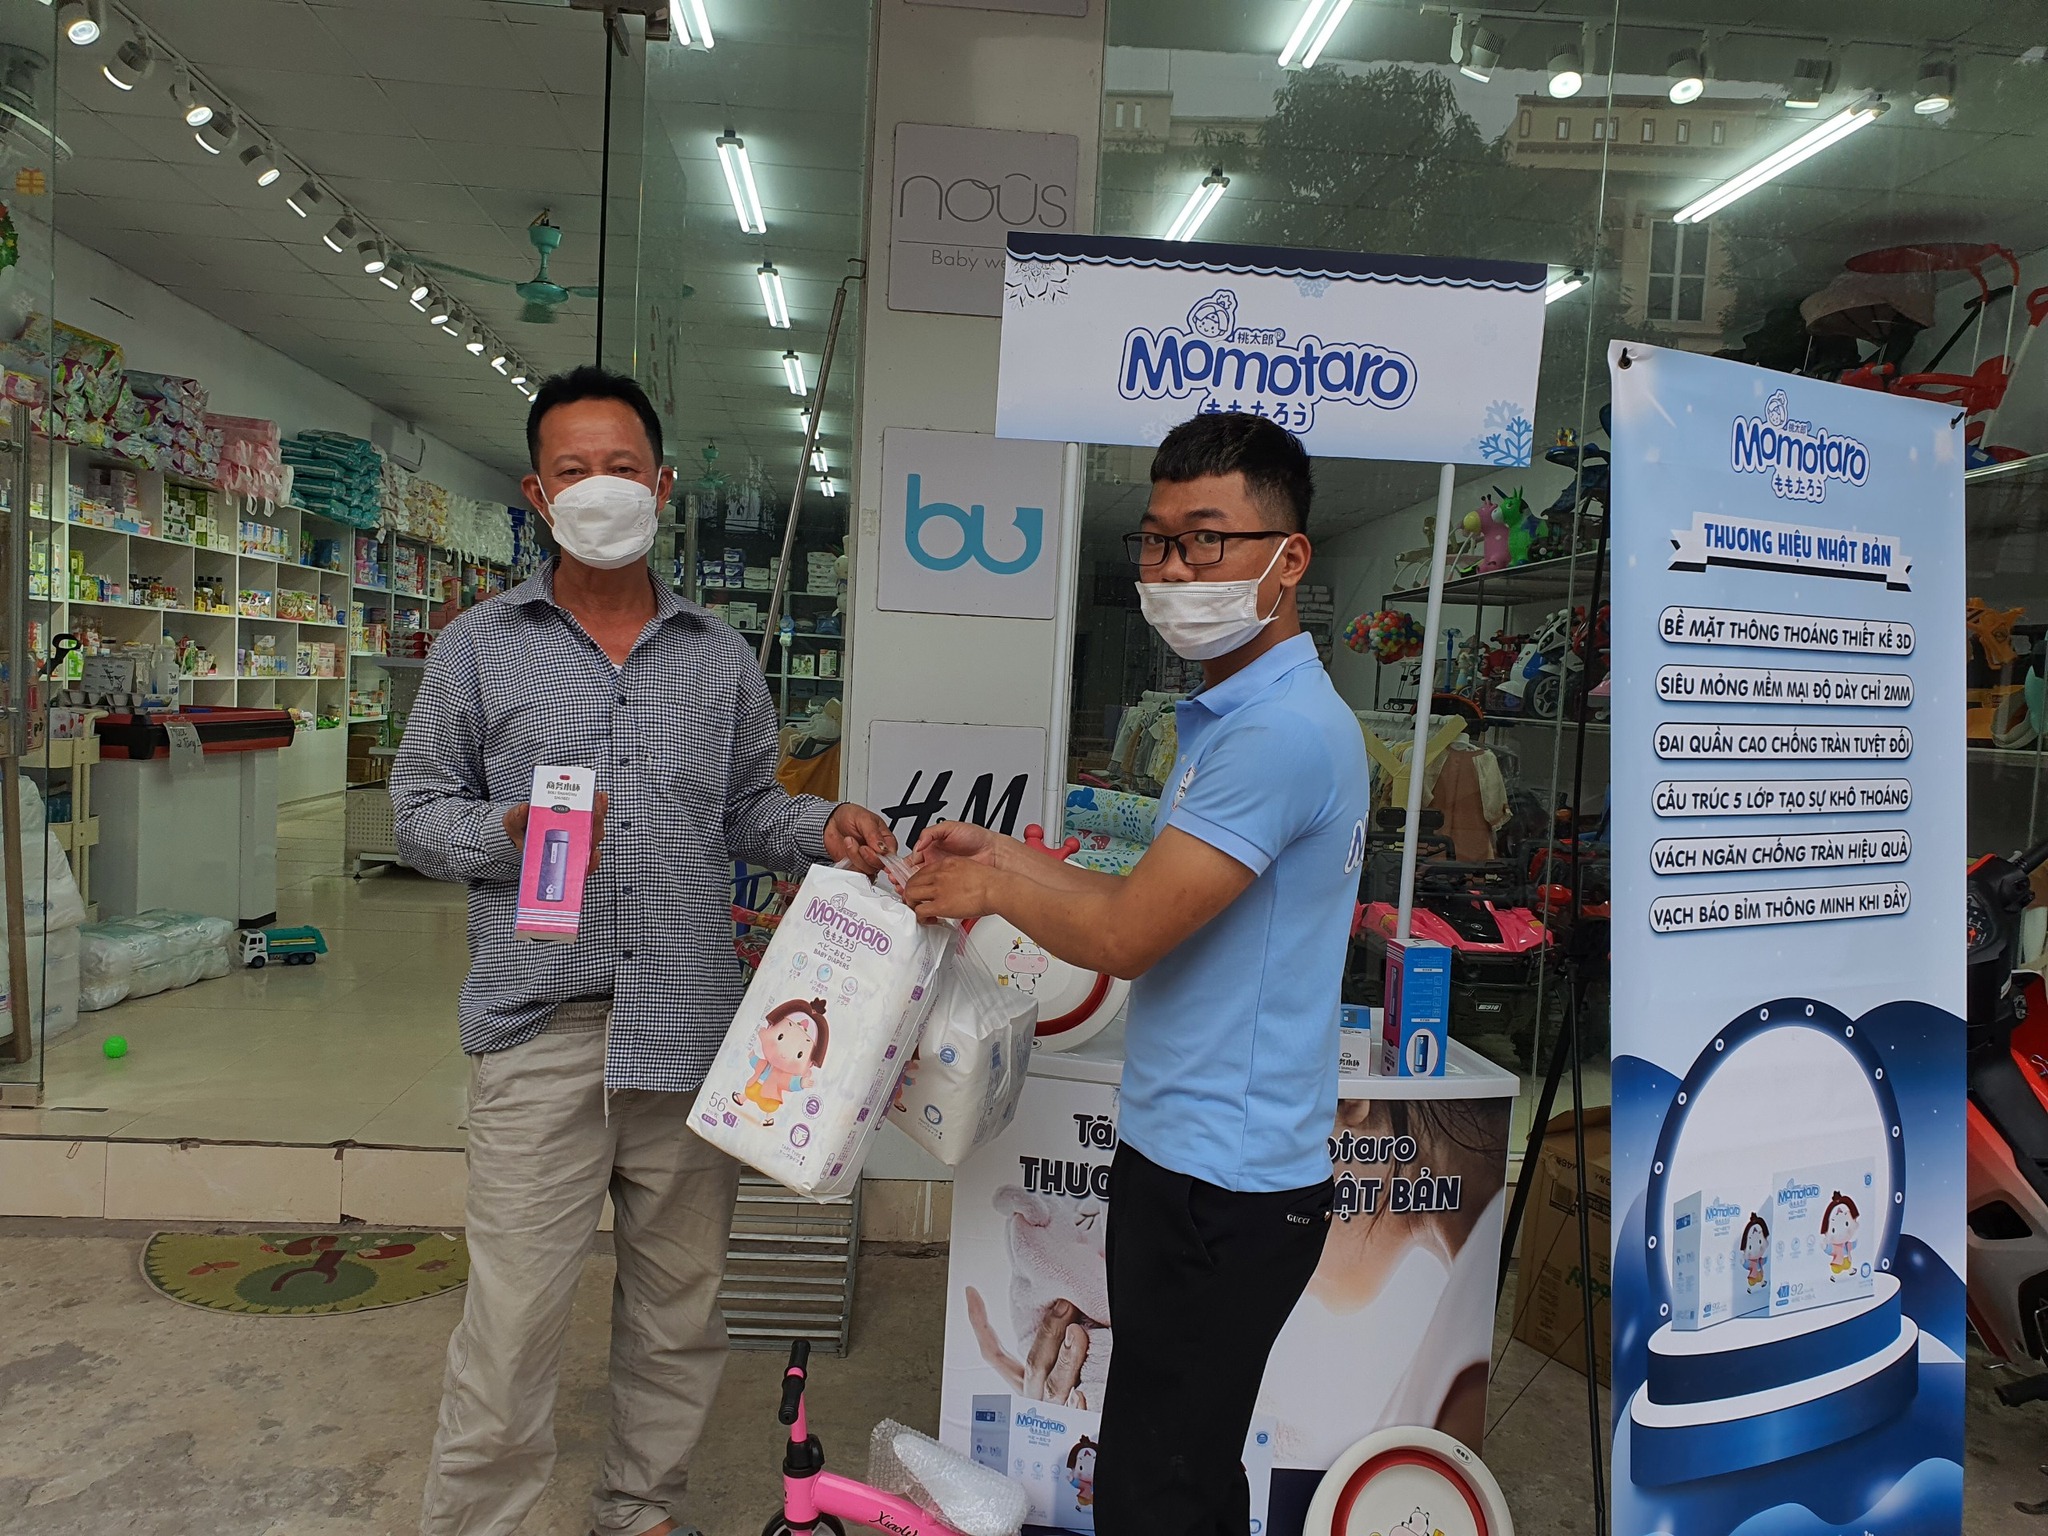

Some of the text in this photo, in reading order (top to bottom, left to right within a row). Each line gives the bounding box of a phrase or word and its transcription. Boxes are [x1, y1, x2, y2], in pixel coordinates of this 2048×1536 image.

[932, 249, 978, 272] Baby
[1237, 332, 1274, 345] 桃太郎
[1126, 335, 1408, 401] Momotaro
[1735, 422, 1866, 480] Momotaro
[1774, 474, 1823, 498] ももたろう
[1704, 523, 1891, 567] THƯƠNG HIỆU NHẬT BẢN
[1664, 608, 1912, 650] BỀ MẶT THÔNG THOÁNG THIẾT KẾ 3D
[1660, 671, 1911, 704] SIÊU MỎNG MỀM MẠI ĐỘ DÀY CHỈ 2MM
[1659, 726, 1910, 757] ĐAI QUẦN CAO CHỐNG TRÀN TUYỆT ĐỐI
[881, 769, 1028, 849] HM
[1656, 783, 1909, 812] CẤU TRÚC 5 LỚP TẠO SỰ KHÔ THOÁNG
[1655, 836, 1908, 868] VÁCH NGĂN CHỐNG TRÀN HIỆU QUẢ
[1654, 884, 1907, 931] VẠCH BÁO BỈM THÔNG MINH KHI ĐẦY
[805, 898, 891, 953] Momotaro
[813, 948, 850, 970] BABY DIAPERS
[709, 1091, 728, 1112] 56
[1073, 1113, 1115, 1148] Tã
[1328, 1129, 1417, 1162] taro
[1333, 1166, 1462, 1220] ẬT BẢN
[1778, 1186, 1820, 1204] Momotaro
[1286, 1213, 1310, 1225] GUCCI
[1790, 1282, 1804, 1297] 92
[1016, 1413, 1066, 1433] Momotaro
